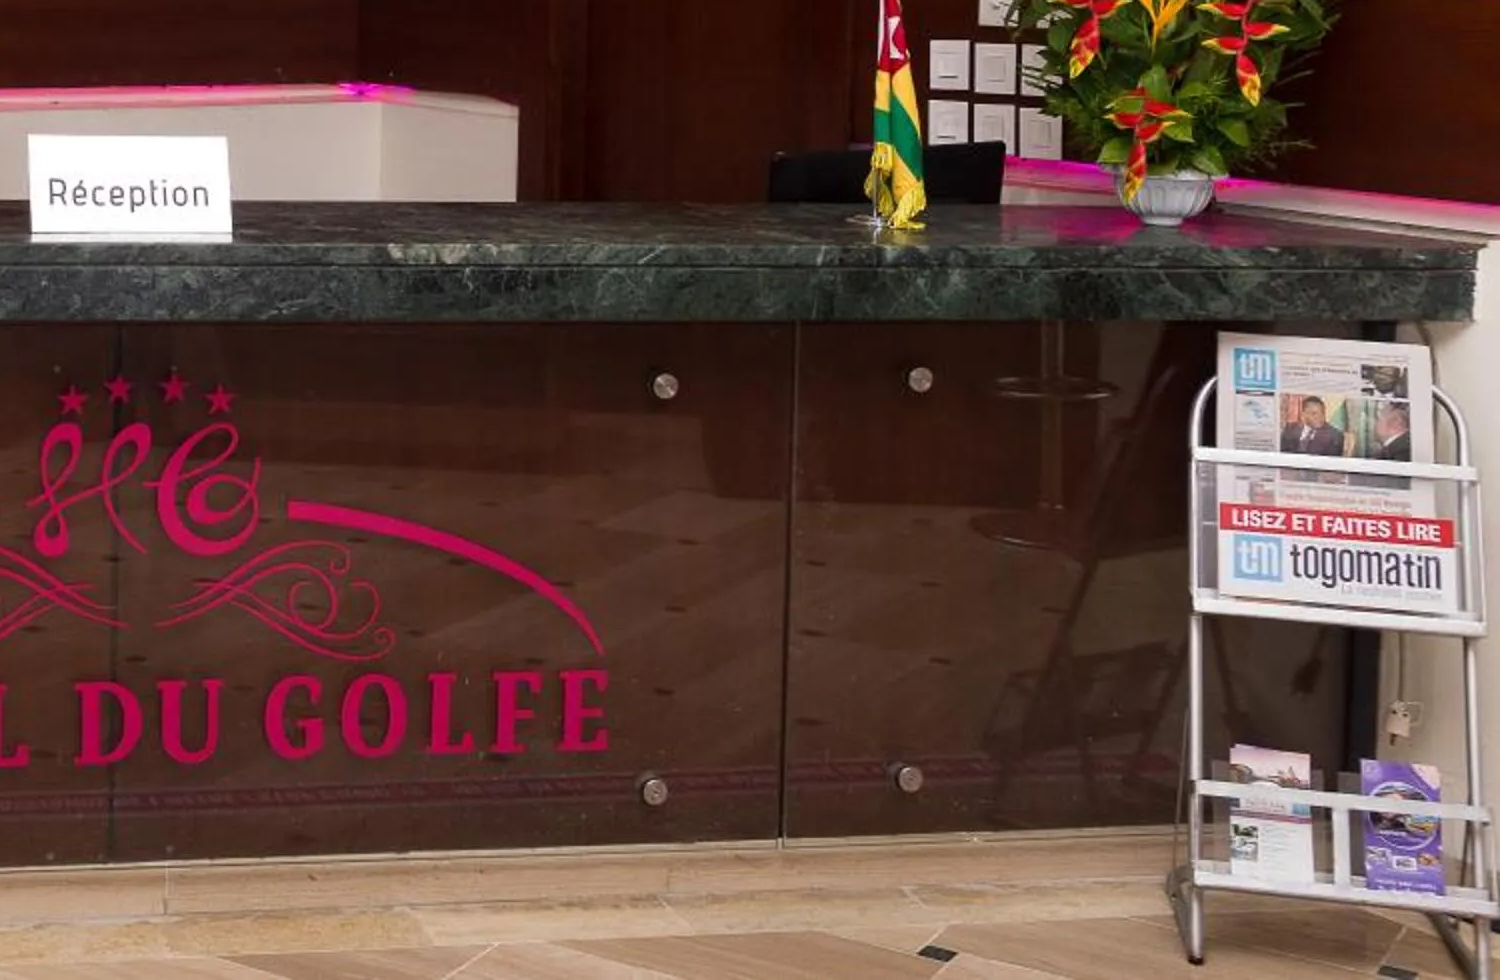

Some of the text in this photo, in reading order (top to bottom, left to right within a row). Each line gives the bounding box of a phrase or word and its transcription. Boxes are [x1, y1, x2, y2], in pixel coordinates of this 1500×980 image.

[48, 177, 210, 213] Réception
[1231, 508, 1442, 542] LISEZ ET FAITES LIRE
[1289, 543, 1443, 591] togomatin
[73, 678, 226, 768] DU
[263, 668, 610, 760] GOLFE
